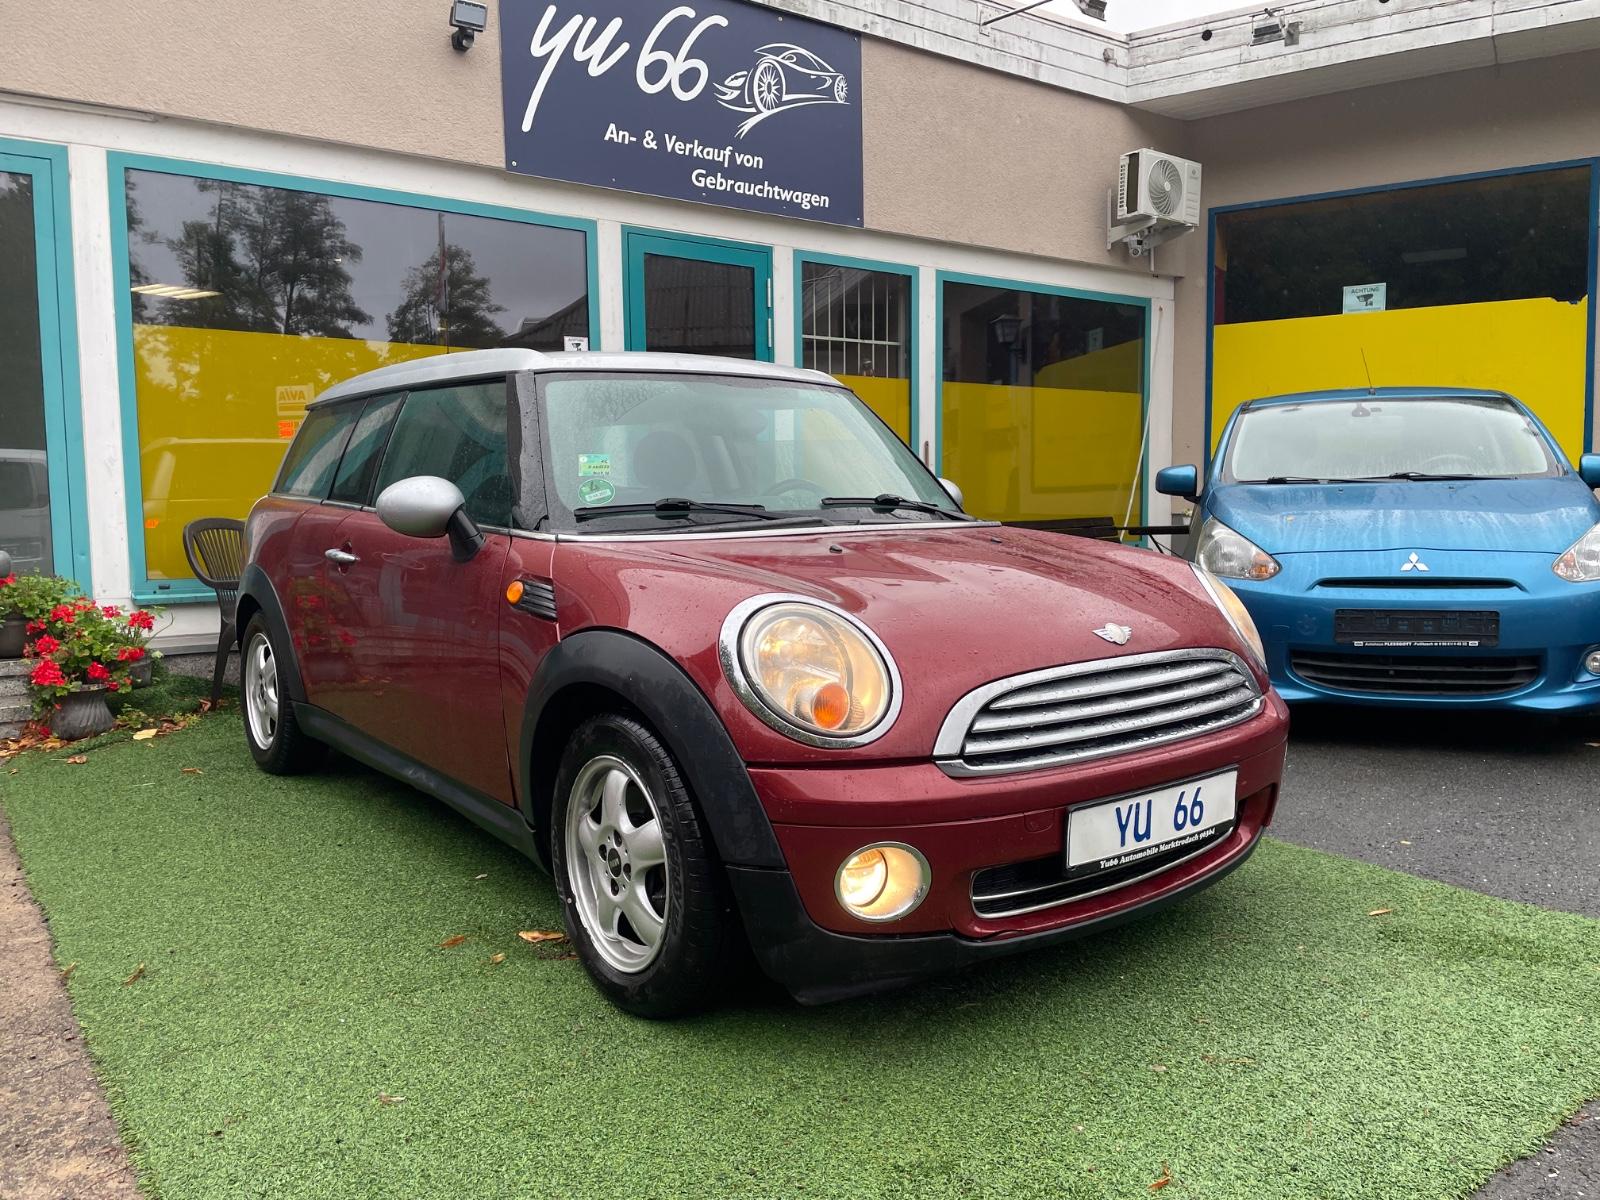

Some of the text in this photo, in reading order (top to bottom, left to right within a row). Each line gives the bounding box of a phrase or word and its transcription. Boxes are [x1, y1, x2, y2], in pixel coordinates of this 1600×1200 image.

[636, 6, 729, 101] 66
[604, 123, 764, 169] An- & Verkauf von
[691, 169, 830, 210] Gebrauchtwagen
[1115, 787, 1204, 848] YU 66
[1100, 859, 1119, 869] Yu66
[1119, 846, 1159, 864] Automobile
[1159, 833, 1199, 852] Marktrodach
